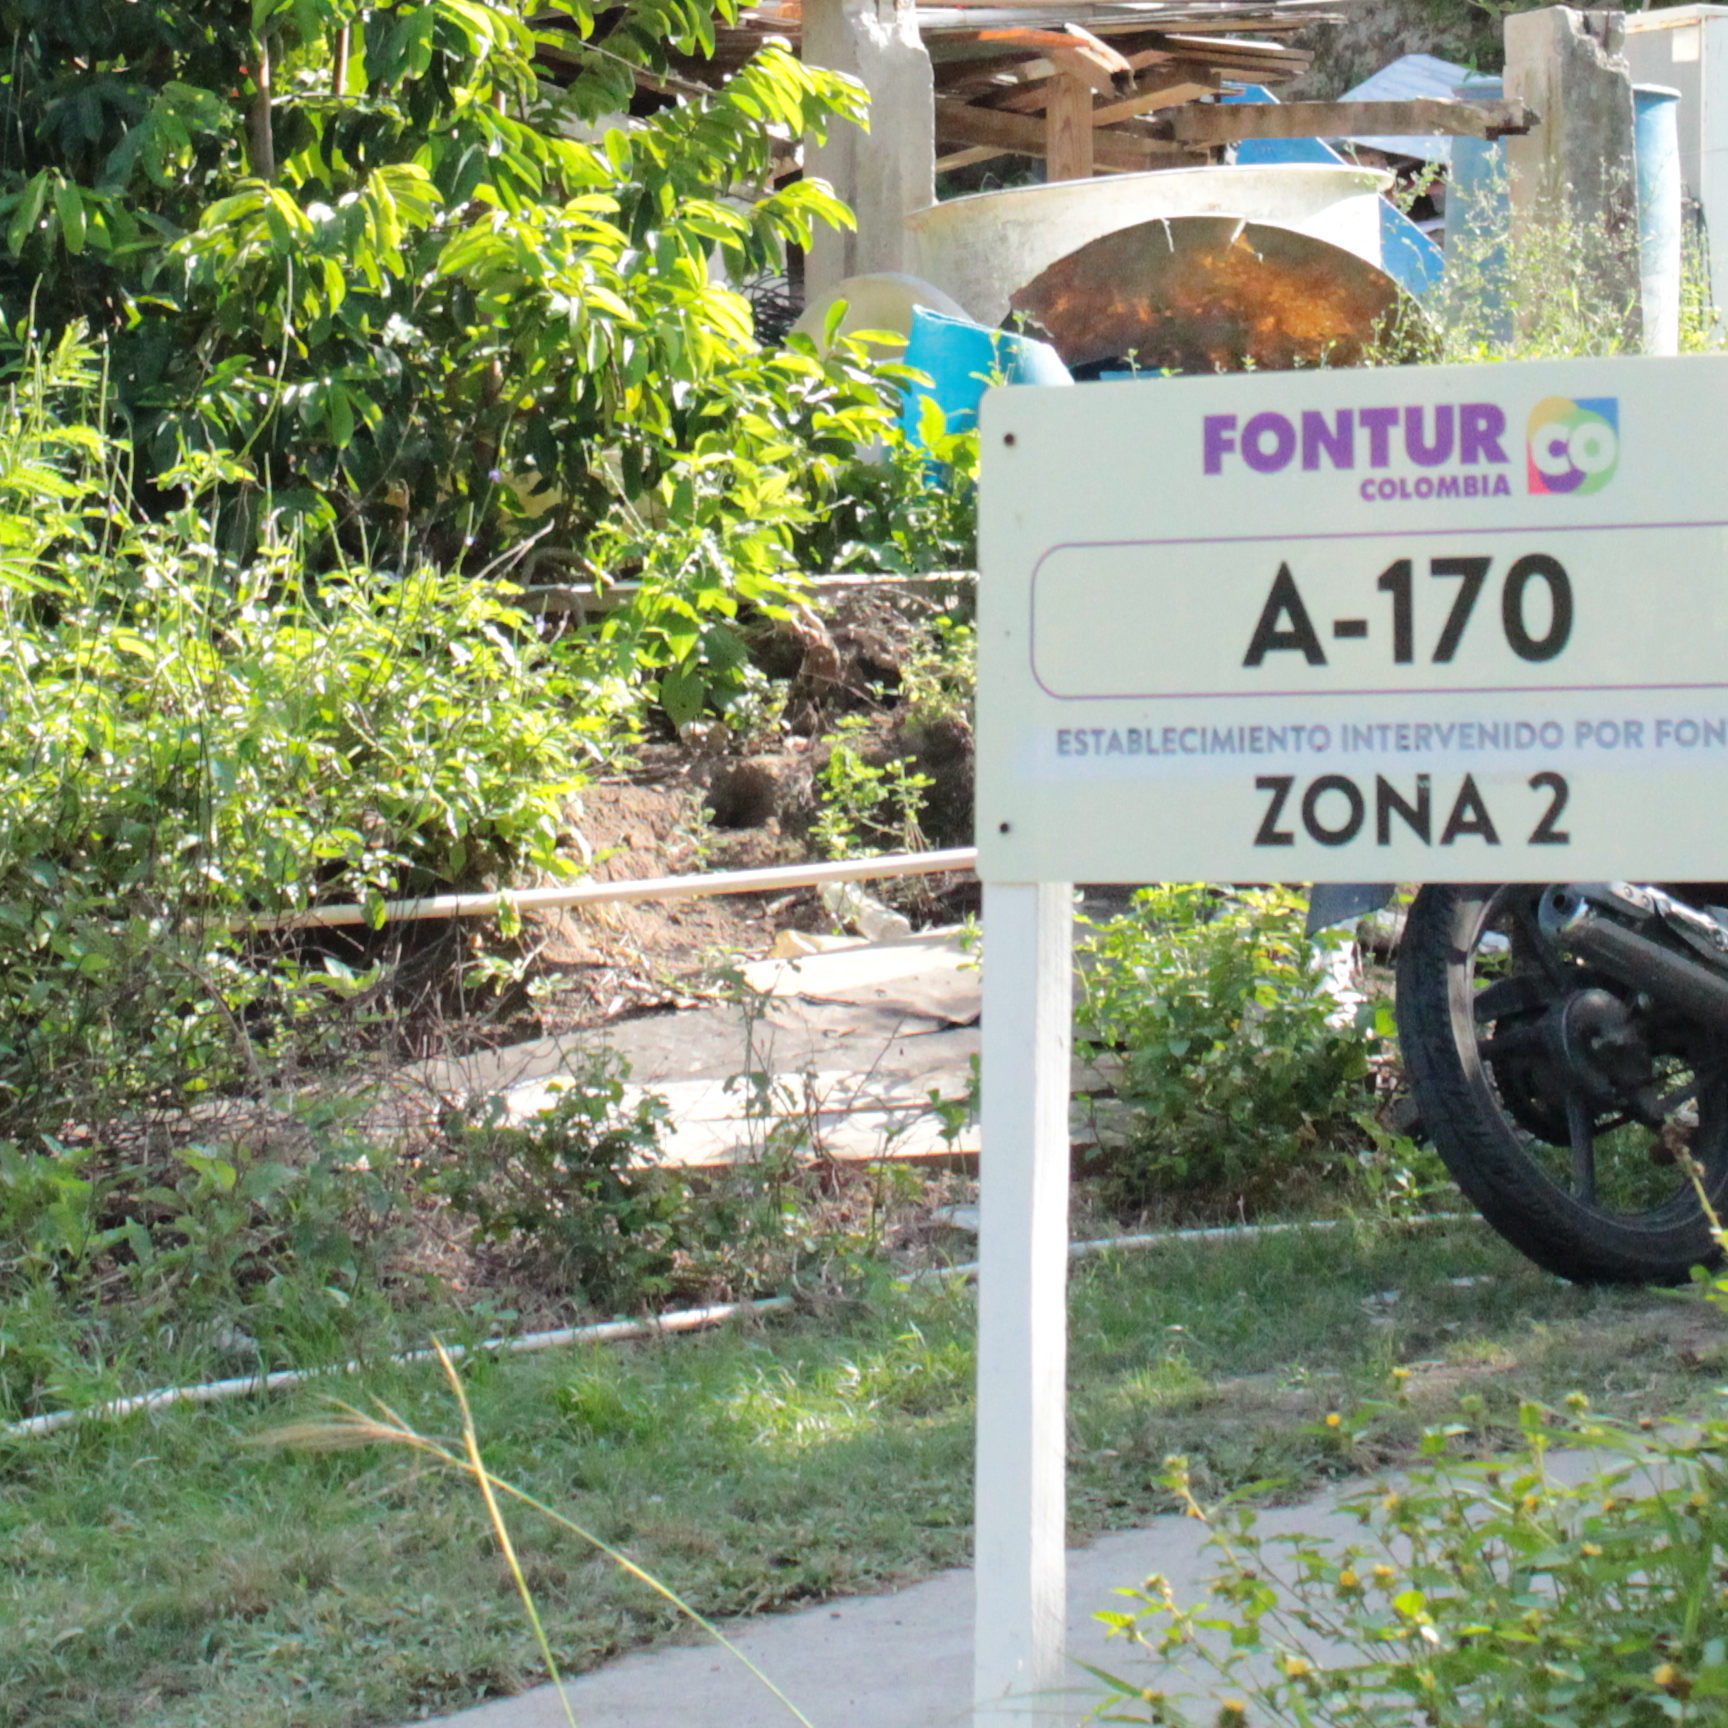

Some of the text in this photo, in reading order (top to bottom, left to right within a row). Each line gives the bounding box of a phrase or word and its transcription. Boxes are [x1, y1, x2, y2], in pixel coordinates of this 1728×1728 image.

[1202, 402, 1511, 475] FONTUR
[1360, 473, 1512, 501] COLOMBIA
[1241, 553, 1574, 667] A-170
[1056, 725, 1332, 756] ESTABLECIMIENTO
[1342, 720, 1564, 754] INTERVENIDO
[1574, 719, 1644, 750] POR
[1253, 770, 1570, 847] ZONA 2
